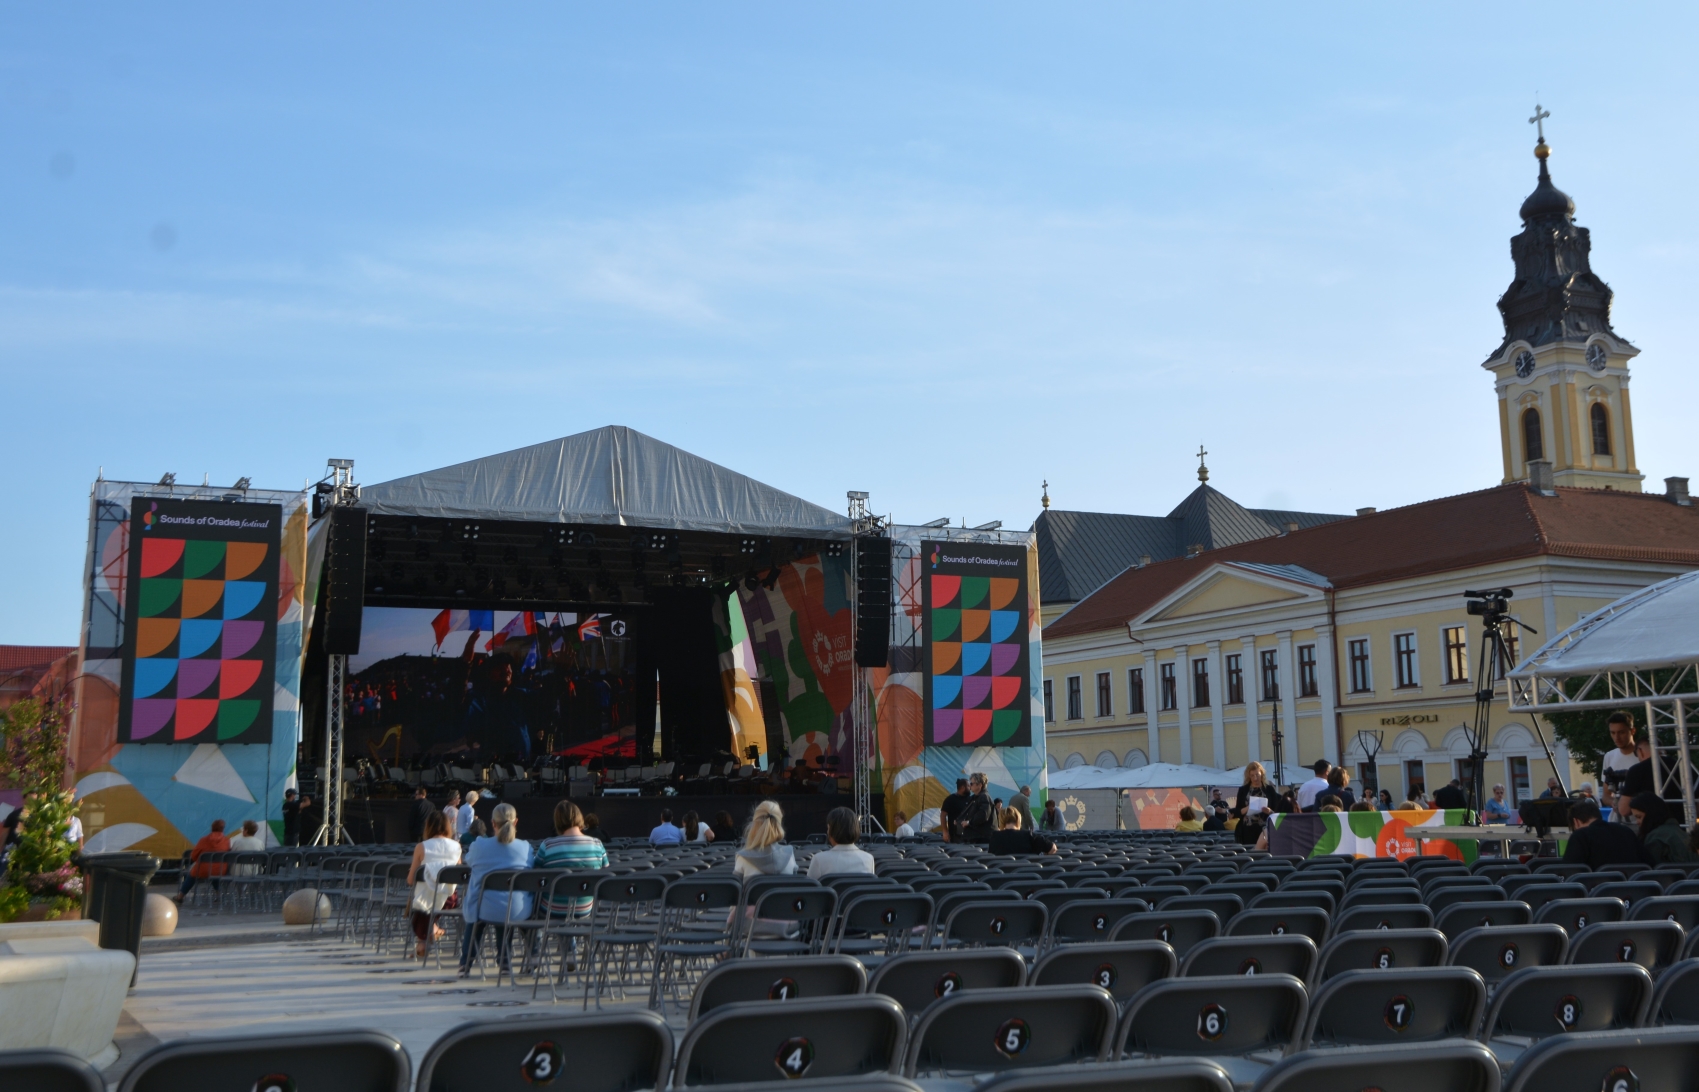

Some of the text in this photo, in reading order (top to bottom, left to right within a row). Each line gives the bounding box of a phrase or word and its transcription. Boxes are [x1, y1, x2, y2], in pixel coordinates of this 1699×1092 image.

[160, 514, 270, 529] Sounds of Oradea festival
[942, 555, 967, 564] Sounds
[967, 556, 975, 564] of
[975, 556, 998, 565] Oradea
[887, 913, 892, 922] 1
[1096, 918, 1104, 929] 2
[1578, 917, 1585, 928] 5
[996, 921, 1002, 932] 1
[1162, 929, 1168, 942] 1
[1504, 950, 1514, 964] 6
[1622, 946, 1631, 960] 7
[1378, 954, 1388, 969] 5
[1100, 971, 1110, 987] 3
[780, 986, 788, 1001] 1
[944, 980, 954, 997] 2
[1393, 1004, 1405, 1024] 7
[1563, 1004, 1574, 1023] 8
[1205, 1013, 1219, 1033] 6
[1005, 1028, 1020, 1050] 5
[535, 1053, 552, 1077] 3
[786, 1047, 803, 1070] 4
